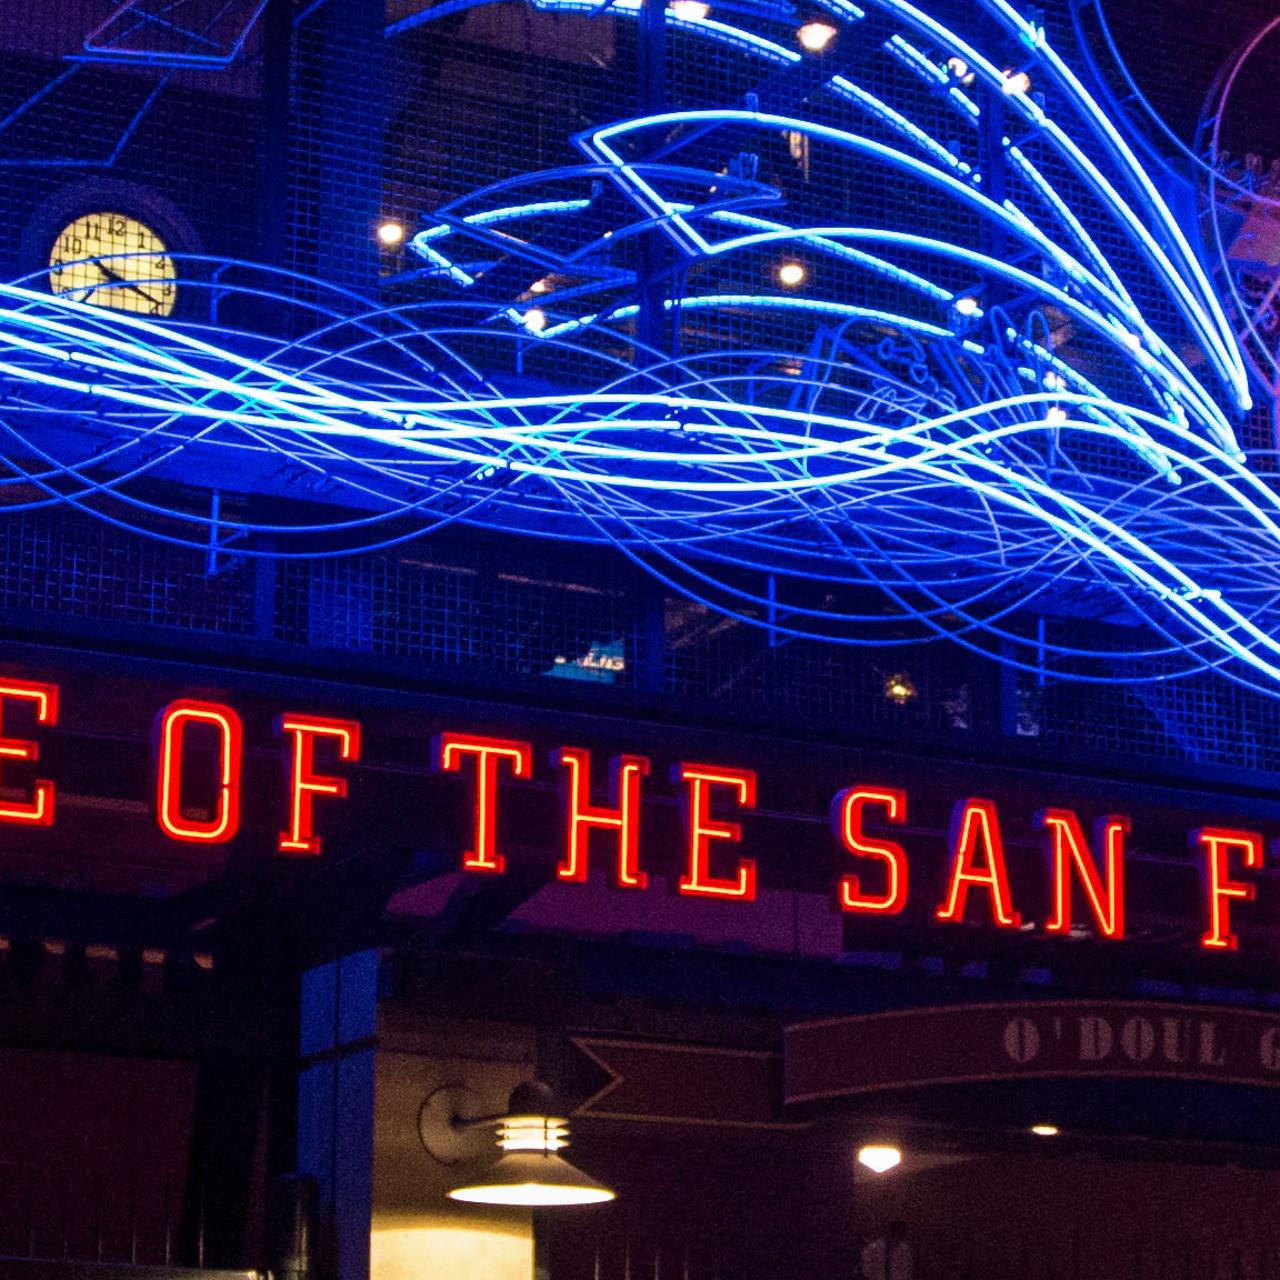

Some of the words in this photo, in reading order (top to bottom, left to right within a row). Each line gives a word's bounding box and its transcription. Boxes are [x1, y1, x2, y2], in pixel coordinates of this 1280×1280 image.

[85, 221, 101, 241] 11
[108, 218, 125, 237] 12
[64, 237, 82, 255] 10
[138, 232, 146, 249] 1
[157, 699, 360, 853] OF
[441, 733, 756, 901] THE
[839, 786, 1129, 939] SAN
[1003, 1017, 1224, 1066] O'DOUL
